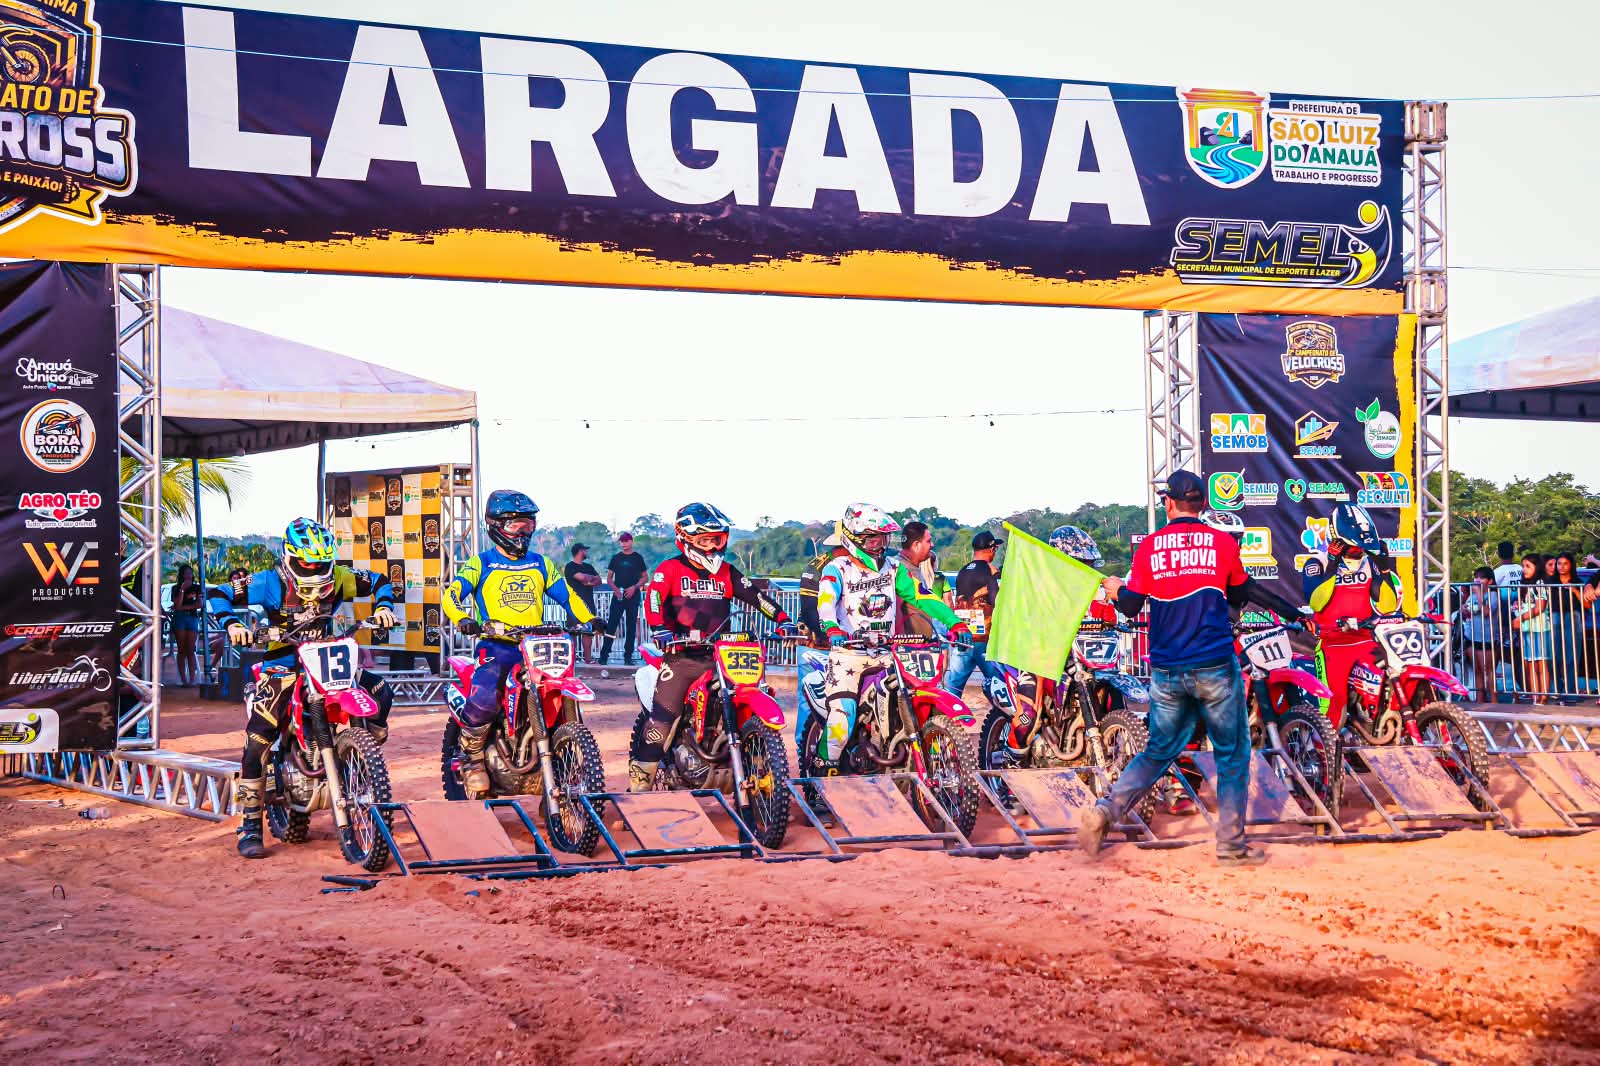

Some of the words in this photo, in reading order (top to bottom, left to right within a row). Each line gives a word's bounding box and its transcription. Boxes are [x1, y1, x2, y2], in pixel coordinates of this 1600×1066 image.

[0, 84, 52, 112] ATO
[59, 88, 94, 115] DE
[182, 6, 1151, 226] LARGADA
[1292, 103, 1343, 115] PREFEITURA
[1346, 106, 1358, 116] DE
[1273, 118, 1320, 141] SÃO
[1327, 123, 1377, 145] LUIZ
[1274, 145, 1302, 163] DO
[1309, 146, 1378, 167] ANAUÁ
[3, 171, 12, 182] E
[14, 172, 63, 194] PAIXÃO!
[1275, 170, 1320, 181] TRABALHO
[1322, 172, 1327, 181] E
[1328, 173, 1378, 184] PROGRESSO
[1173, 219, 1350, 267] SEMEL
[1177, 264, 1222, 273] SECRETARIA
[1223, 265, 1263, 274] MUNICIPAL
[1264, 267, 1275, 275] DE
[1276, 267, 1309, 276] ESPORTE
[1310, 268, 1315, 276] E
[1316, 268, 1341, 277] LAZER
[27, 358, 72, 371] Anauá
[1285, 356, 1343, 371] VELOCROSS
[28, 370, 67, 382] União
[35, 434, 81, 446] BORA
[1212, 435, 1268, 448] SEMOB
[37, 445, 79, 454] AVUAR
[1300, 446, 1336, 455] SEMOF
[1244, 483, 1278, 493] SEMLIC
[1309, 483, 1345, 492] SEMSA
[20, 494, 65, 508] AGRO
[69, 491, 100, 508] TÉO
[1357, 490, 1410, 504] SECULTI
[1153, 532, 1215, 551] DIRETOR
[22, 541, 100, 587] WE
[1151, 552, 1168, 572] DE
[1170, 549, 1217, 569] PROVA
[1153, 570, 1177, 580] MICHEL
[1179, 568, 1216, 576] AGORRETA
[1334, 570, 1367, 584] aero
[32, 587, 94, 597] PRODUÇÕES
[63, 624, 113, 634] MOTOS
[1085, 641, 1117, 659] 27
[1389, 632, 1421, 654] 96
[1258, 641, 1286, 664] 111
[318, 644, 352, 684] 13
[728, 652, 759, 670] 332
[9, 670, 89, 685] Liberdade
